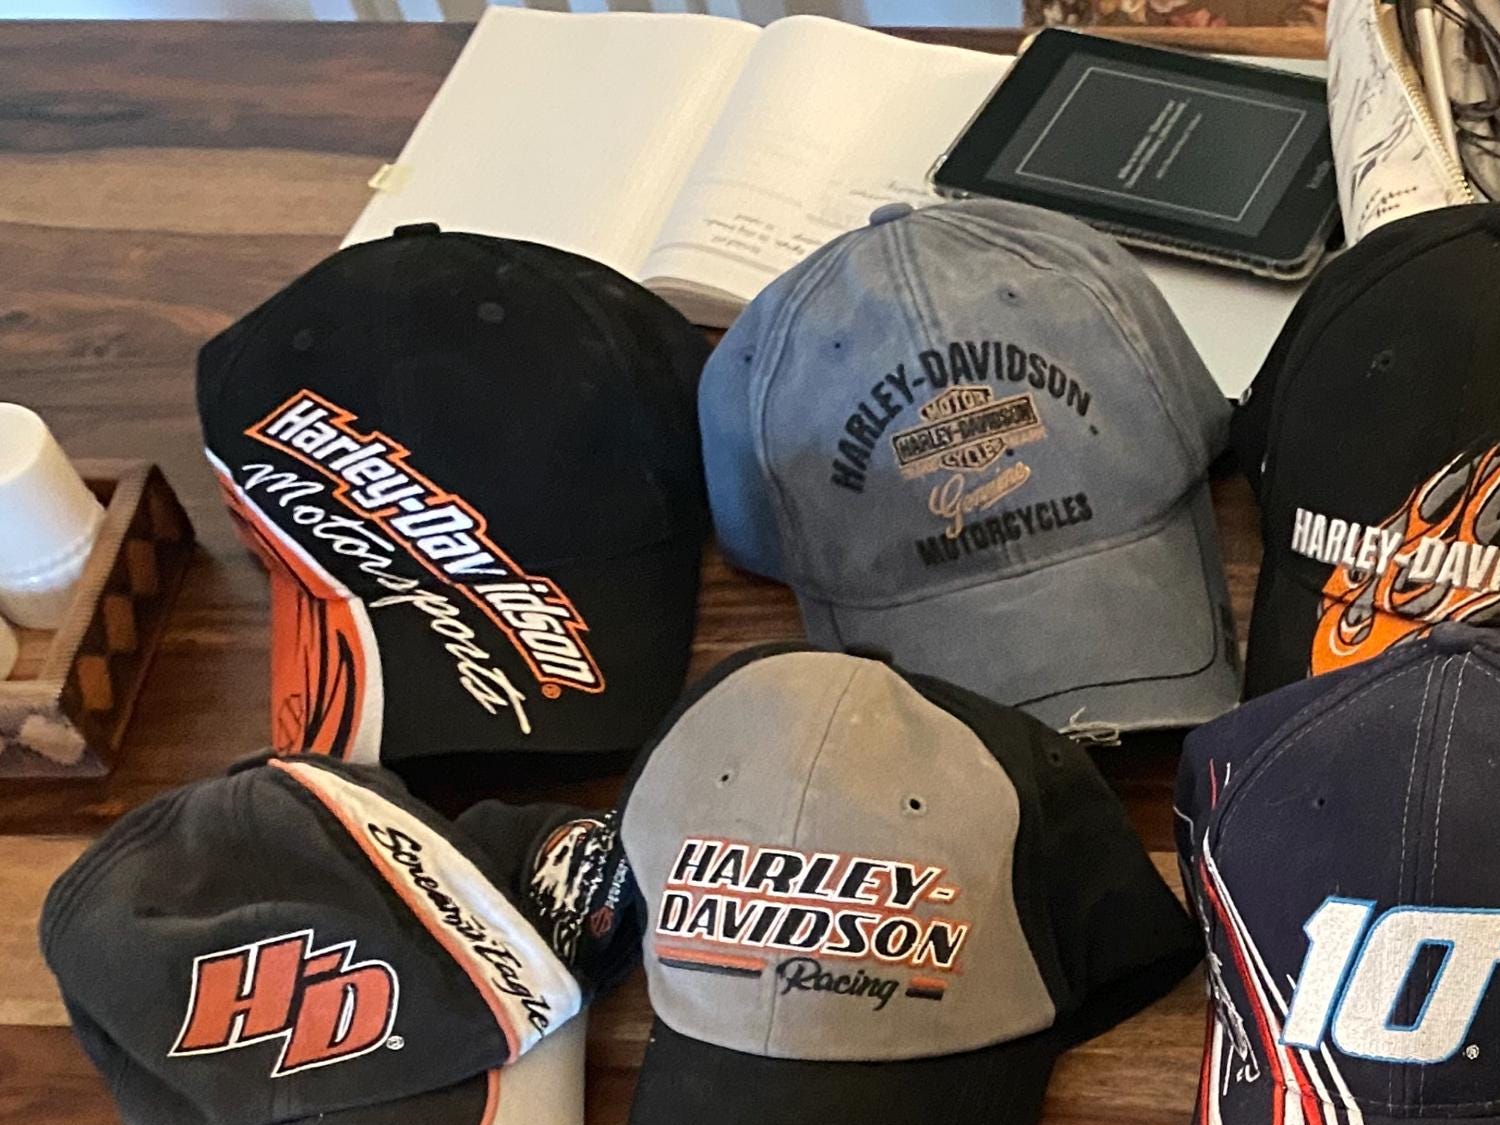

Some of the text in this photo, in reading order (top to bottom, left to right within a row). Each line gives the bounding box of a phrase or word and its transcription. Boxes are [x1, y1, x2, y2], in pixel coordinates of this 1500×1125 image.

[831, 340, 1092, 493] HARLEY-DAVIDSON
[266, 400, 597, 687] Harley-Davidson
[915, 492, 1093, 567] MOTORCYCLES
[243, 460, 532, 734] Motorsports
[668, 838, 955, 910] HARLEY-
[656, 889, 968, 969] DAVIDSON
[474, 941, 551, 1039] Eagle
[775, 956, 899, 1011] Racing
